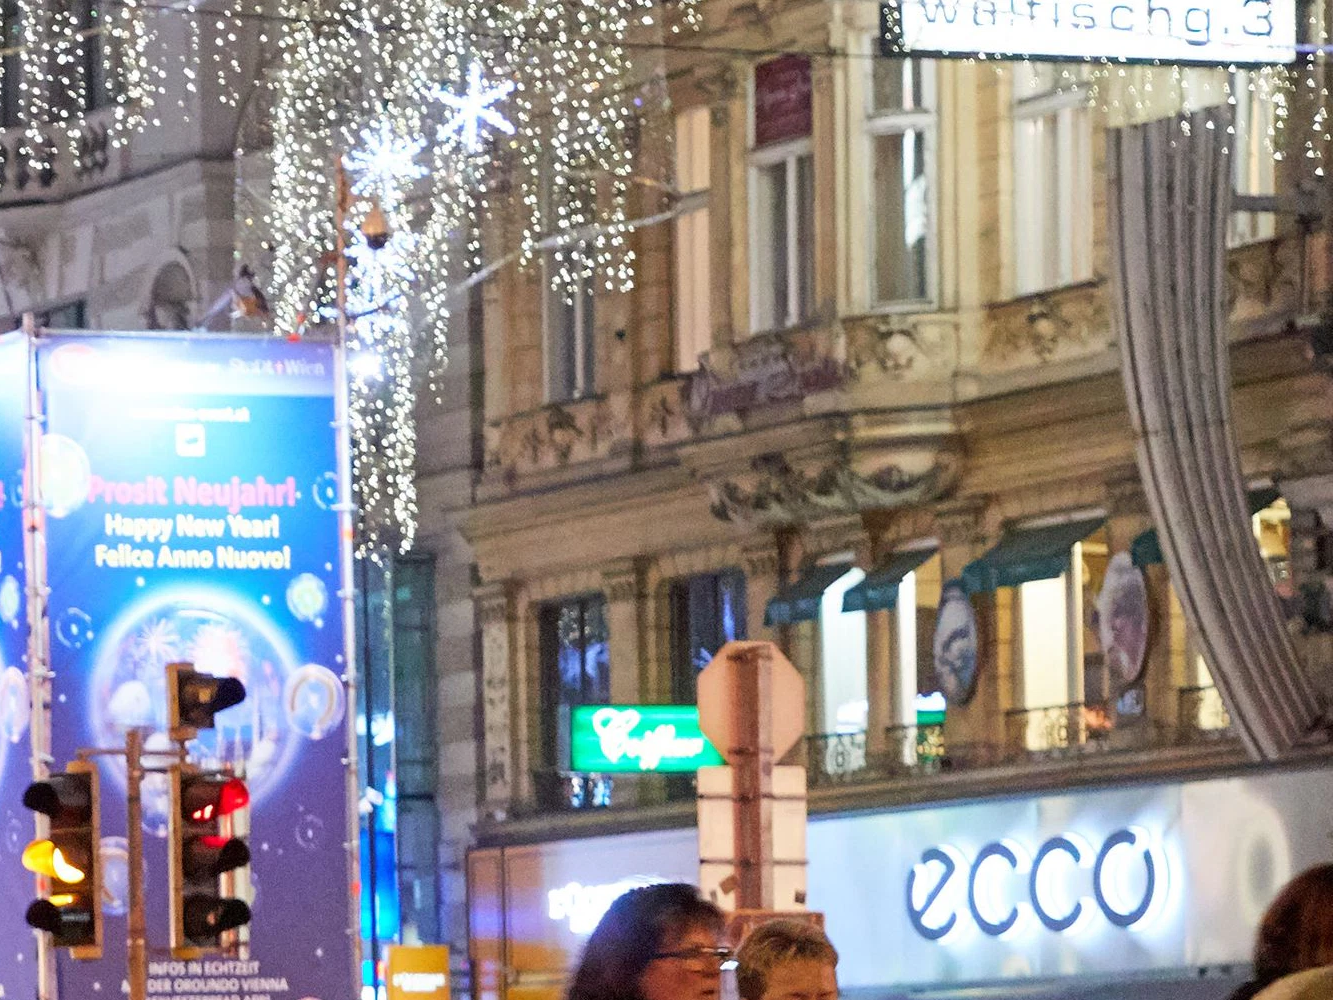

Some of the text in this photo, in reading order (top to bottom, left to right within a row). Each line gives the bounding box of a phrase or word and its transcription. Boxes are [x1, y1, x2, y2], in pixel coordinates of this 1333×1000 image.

[87, 475, 296, 515] Prosit Neujahr!
[104, 512, 280, 543] Happy New Year!
[94, 543, 291, 570] Felice Anno Nuovo!
[906, 829, 1156, 941] ecco
